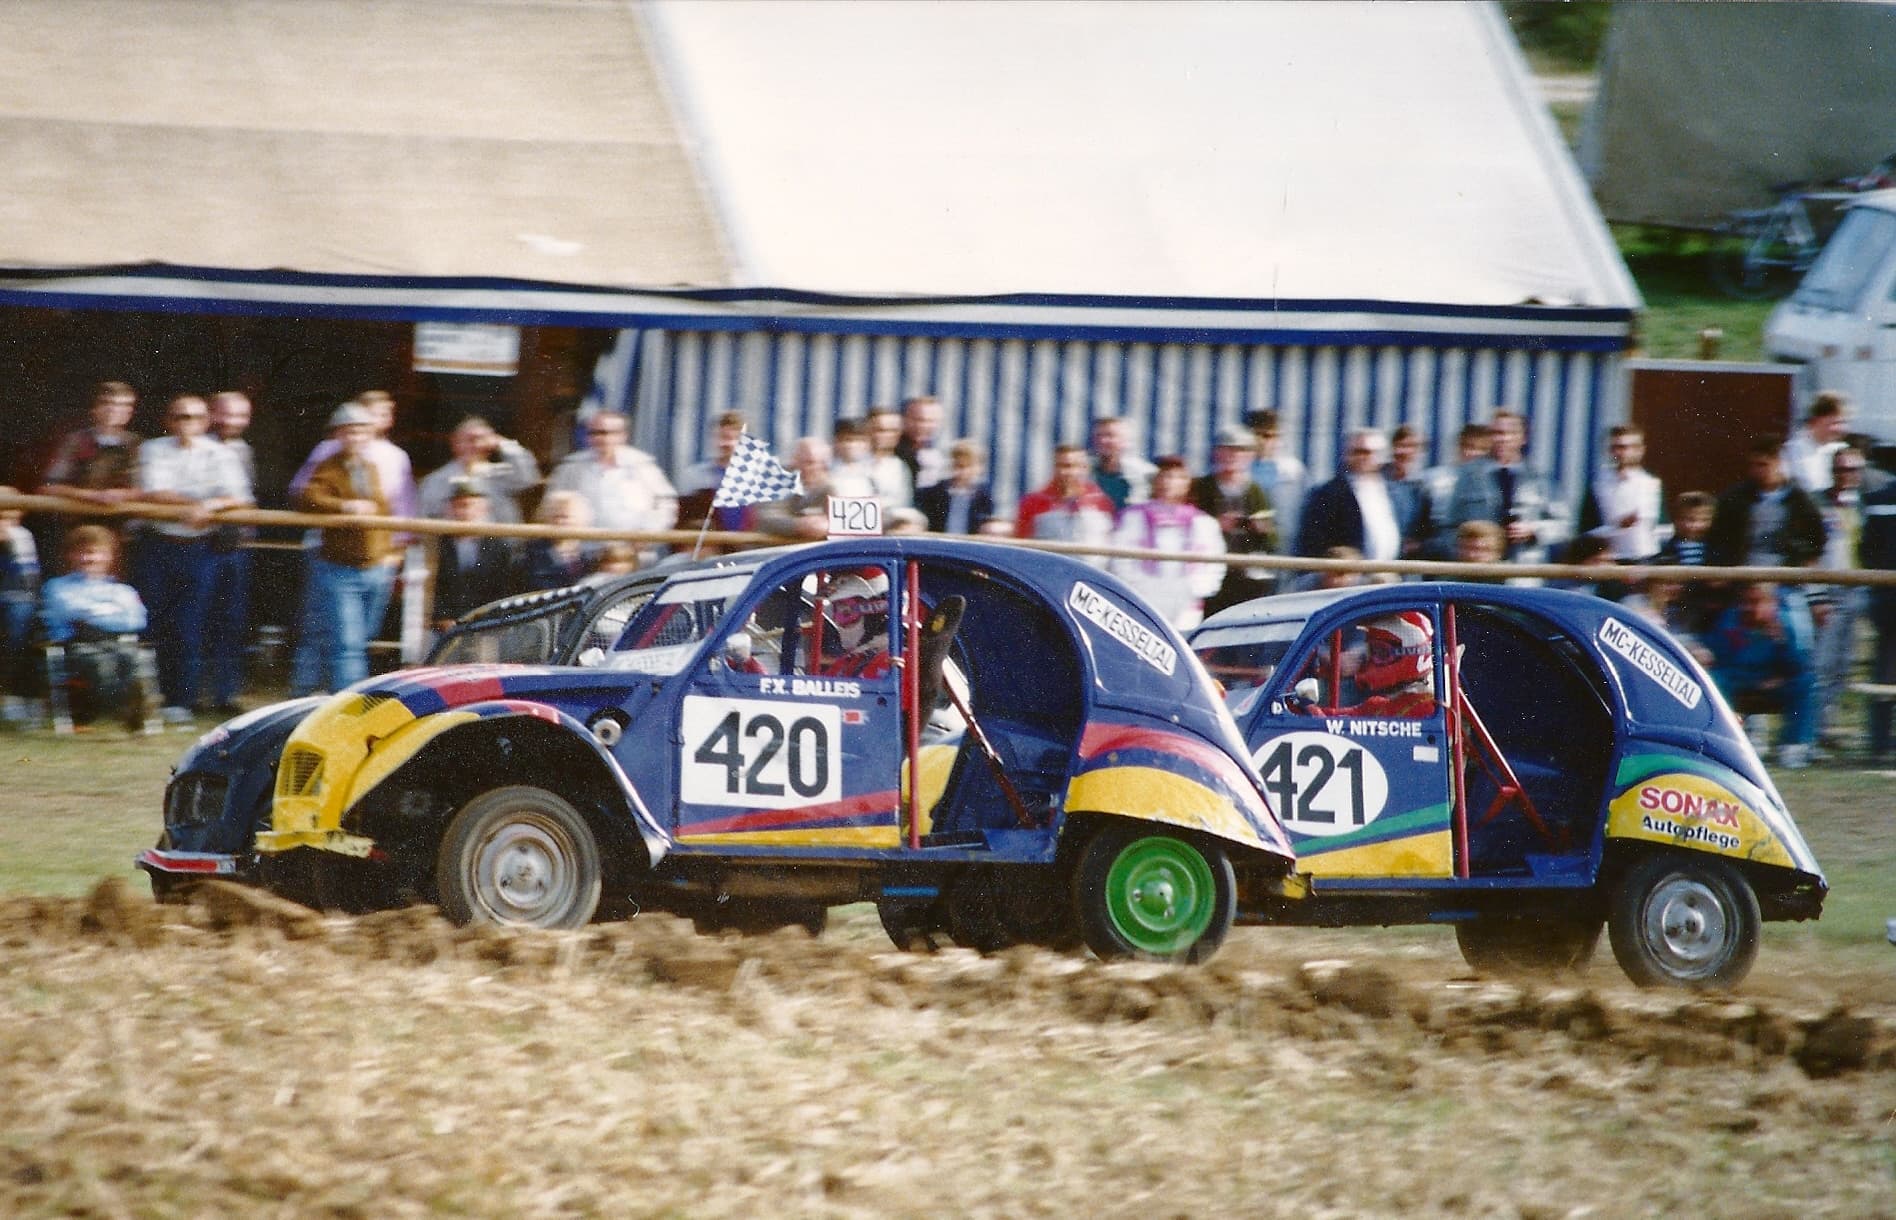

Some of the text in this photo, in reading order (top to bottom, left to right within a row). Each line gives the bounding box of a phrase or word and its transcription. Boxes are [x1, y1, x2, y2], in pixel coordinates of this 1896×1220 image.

[832, 500, 878, 530] 420
[1073, 586, 1174, 672] MC-KESSELTAL
[1603, 622, 1697, 705] MC-KESSELTAL
[694, 710, 829, 798] 420
[1326, 719, 1422, 738] W. NITSCHE
[1258, 741, 1366, 826] 421
[1639, 785, 1741, 829] SONAX
[1642, 814, 1741, 850] Autopflege
